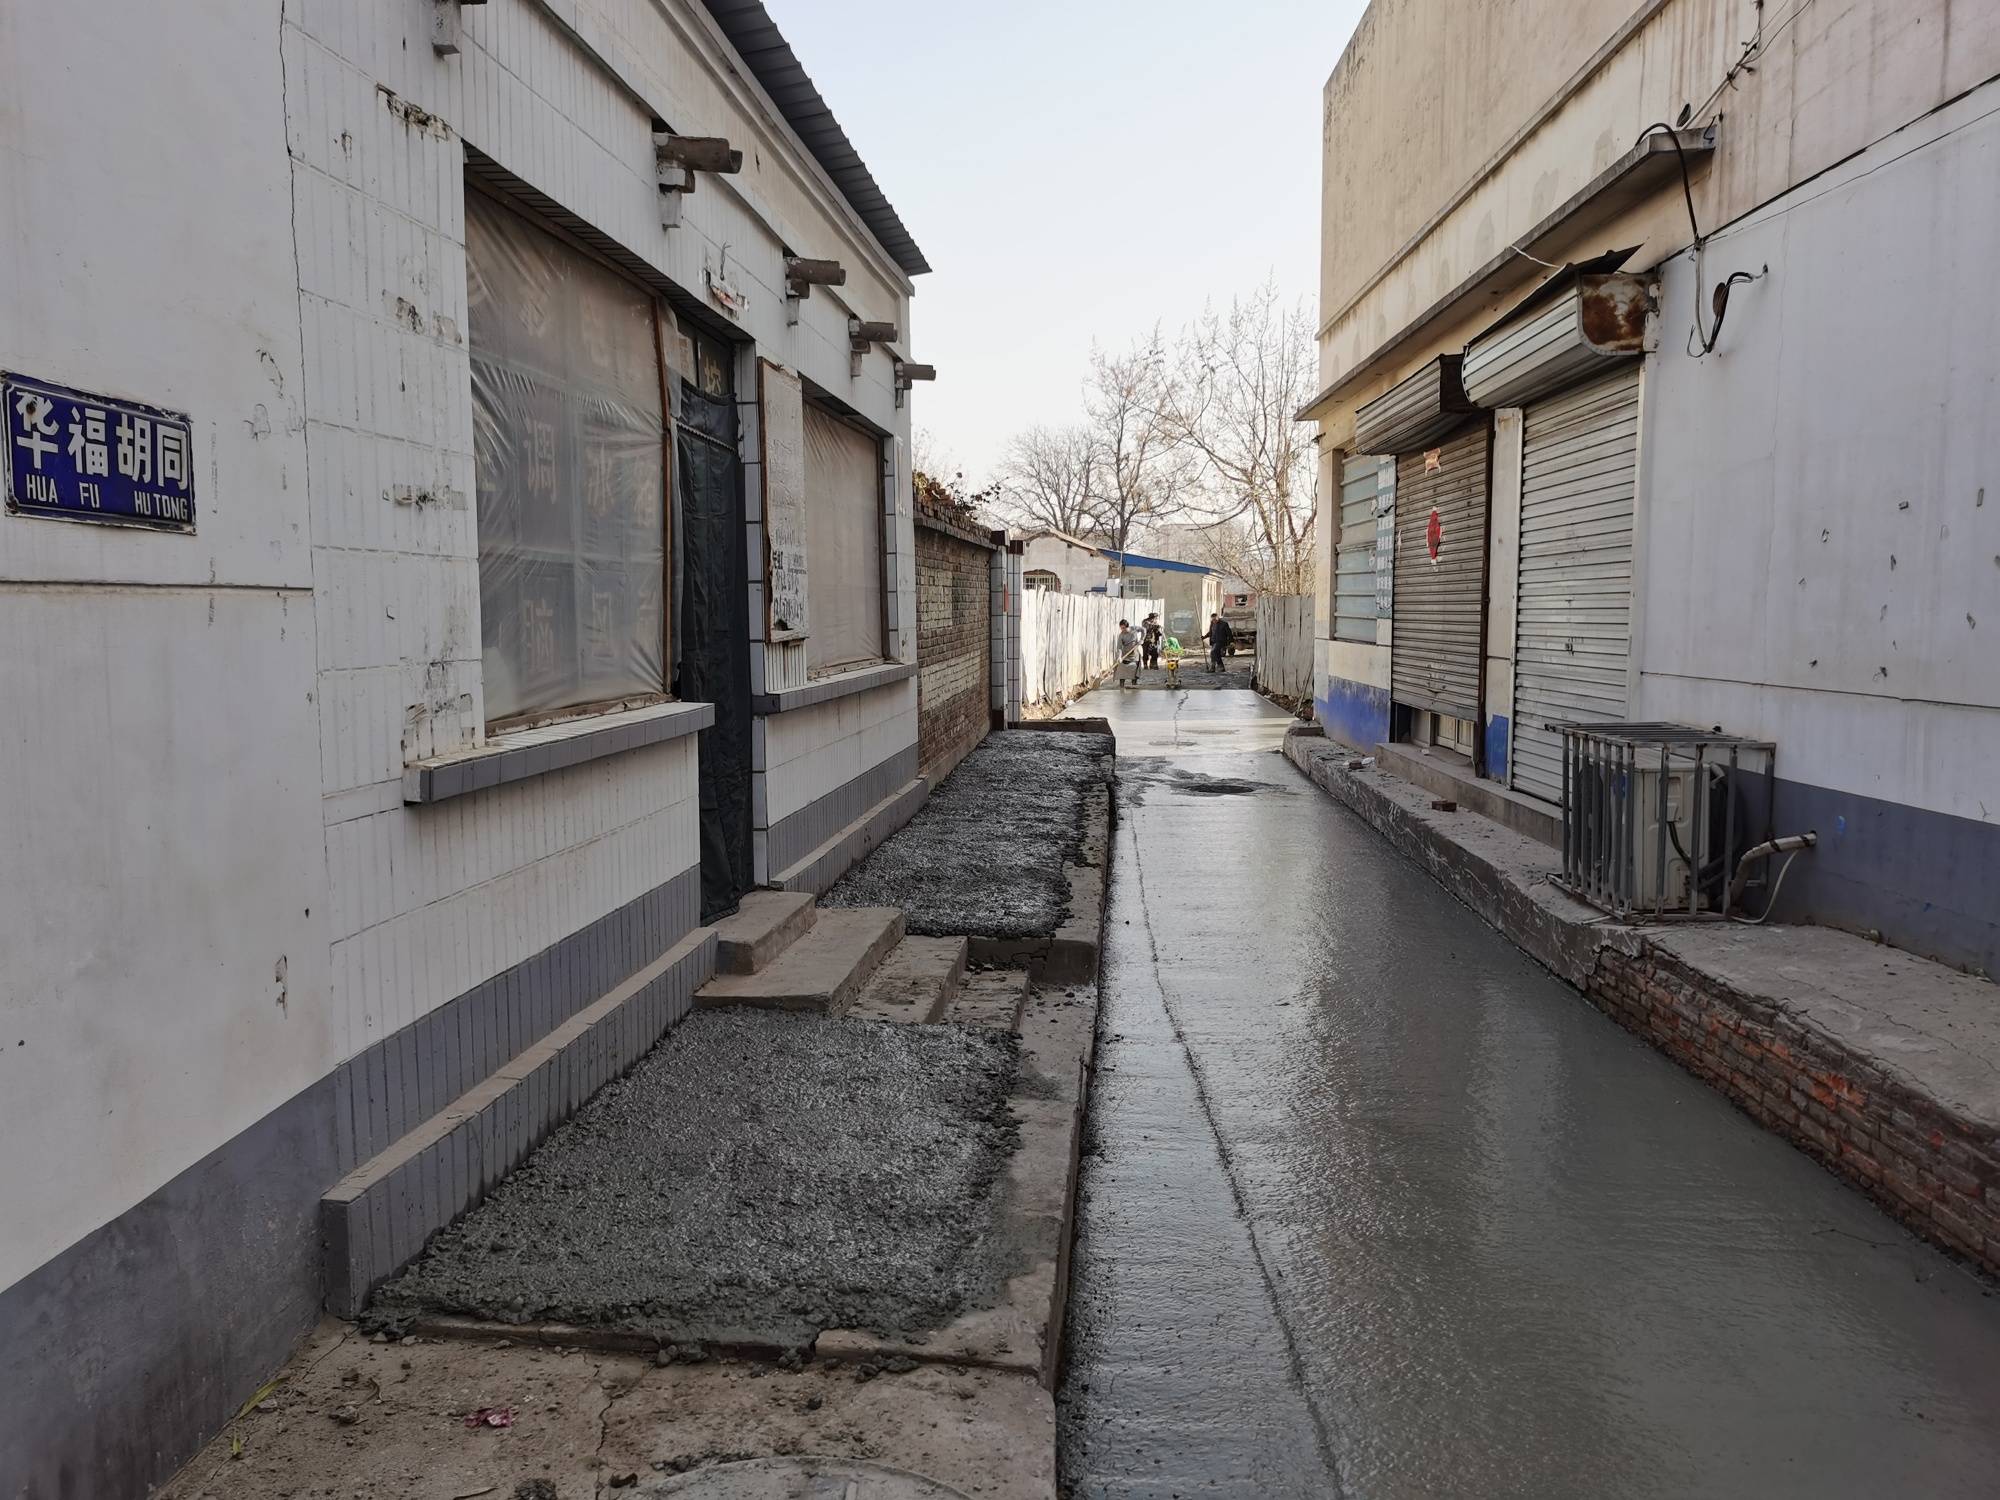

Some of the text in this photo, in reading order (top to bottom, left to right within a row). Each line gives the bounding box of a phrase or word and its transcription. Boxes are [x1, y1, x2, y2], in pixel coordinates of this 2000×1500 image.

[15, 391, 189, 490] 华福胡同
[26, 474, 58, 504] HUA
[79, 482, 100, 508] FU
